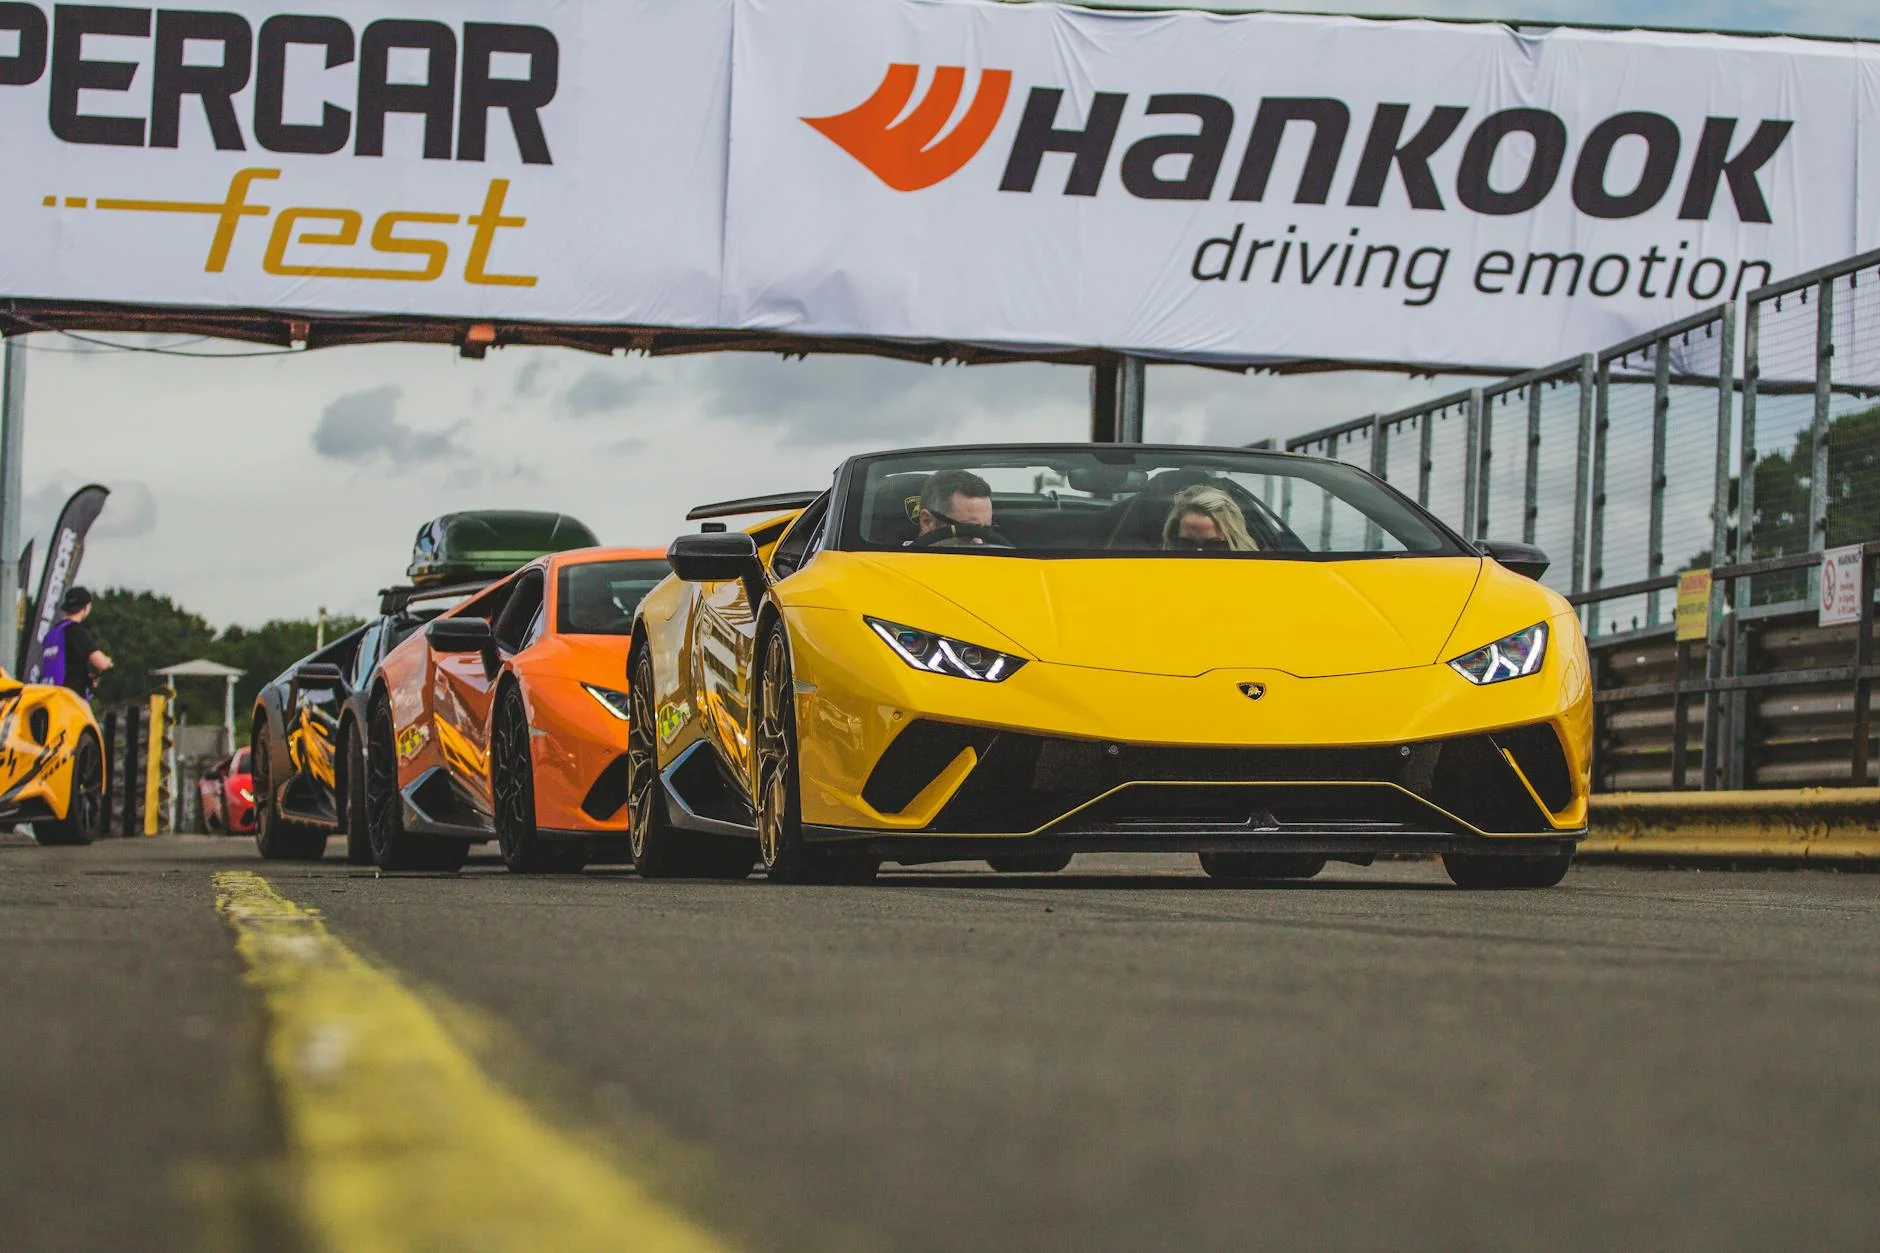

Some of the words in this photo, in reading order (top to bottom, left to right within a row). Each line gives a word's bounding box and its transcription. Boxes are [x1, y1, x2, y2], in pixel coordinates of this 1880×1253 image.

[96, 168, 538, 287] fest
[1191, 222, 1450, 307] driving
[1474, 240, 1773, 301] emotion
